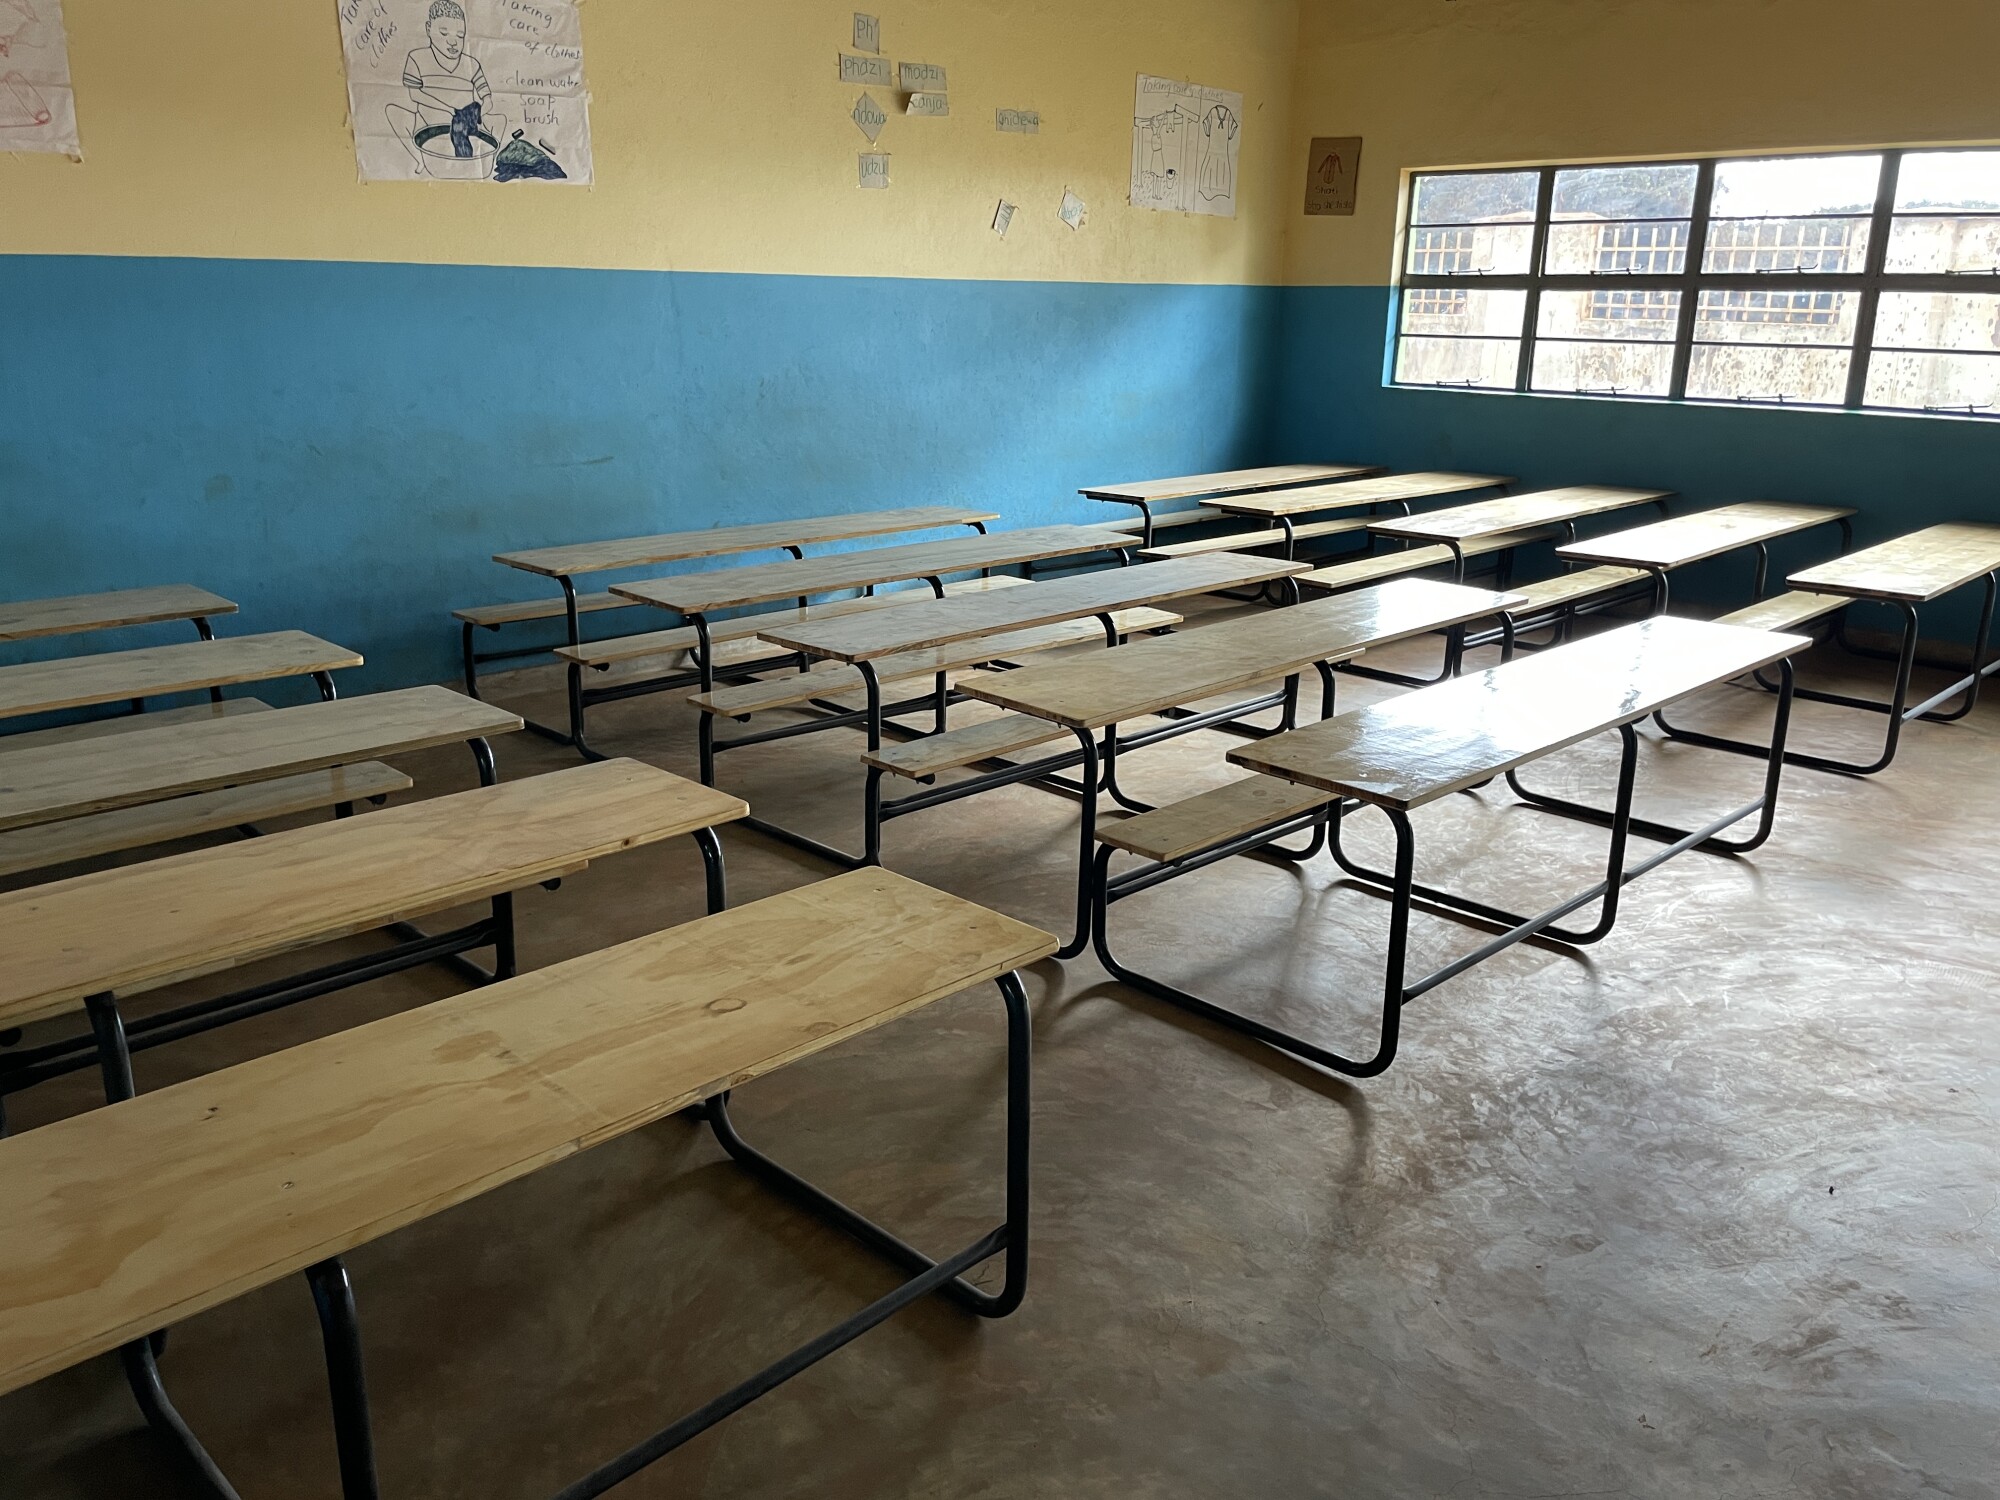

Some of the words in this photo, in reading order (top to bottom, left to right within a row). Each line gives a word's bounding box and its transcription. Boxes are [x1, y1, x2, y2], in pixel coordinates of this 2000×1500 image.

[370, 21, 398, 69] clothes
[524, 41, 540, 55] of
[523, 109, 559, 126] brush
